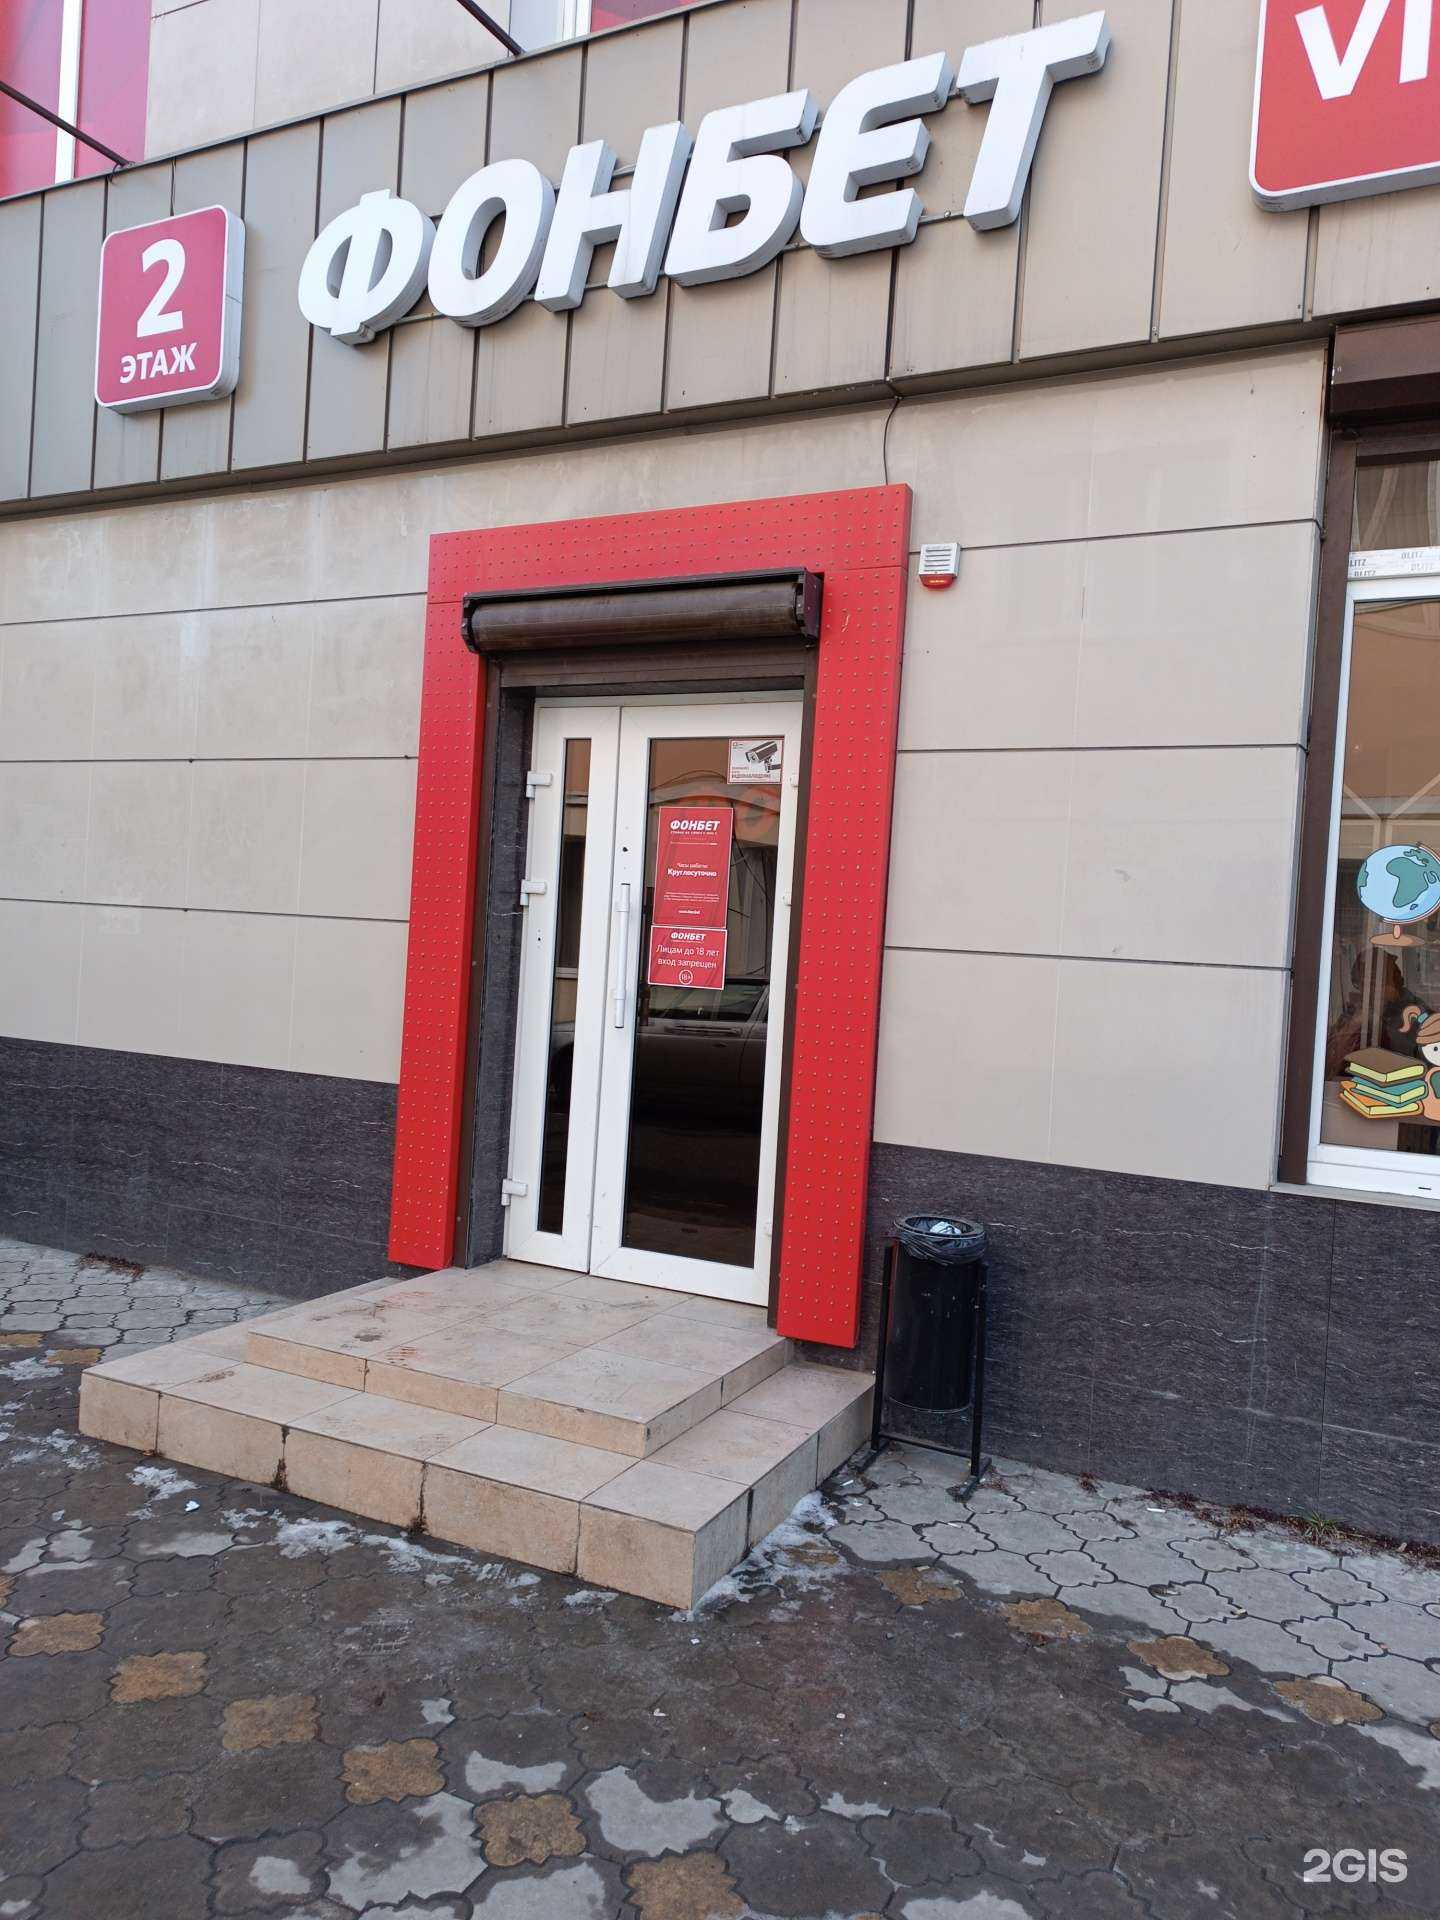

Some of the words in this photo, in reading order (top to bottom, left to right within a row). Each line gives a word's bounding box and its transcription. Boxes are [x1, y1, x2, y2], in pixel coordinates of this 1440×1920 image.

[298, 10, 1110, 343] ФОНБЕТ
[136, 238, 186, 338] 2
[119, 342, 198, 384] ЭТАЖ
[670, 820, 721, 831] ФОНБЕТ
[667, 868, 717, 877] Круглосуточно
[670, 932, 707, 941] ФОНБЕТ
[656, 944, 683, 955] Лицам
[683, 948, 695, 956] до
[696, 947, 705, 956] 18
[657, 958, 676, 967] вход
[677, 960, 717, 969] запрещен
